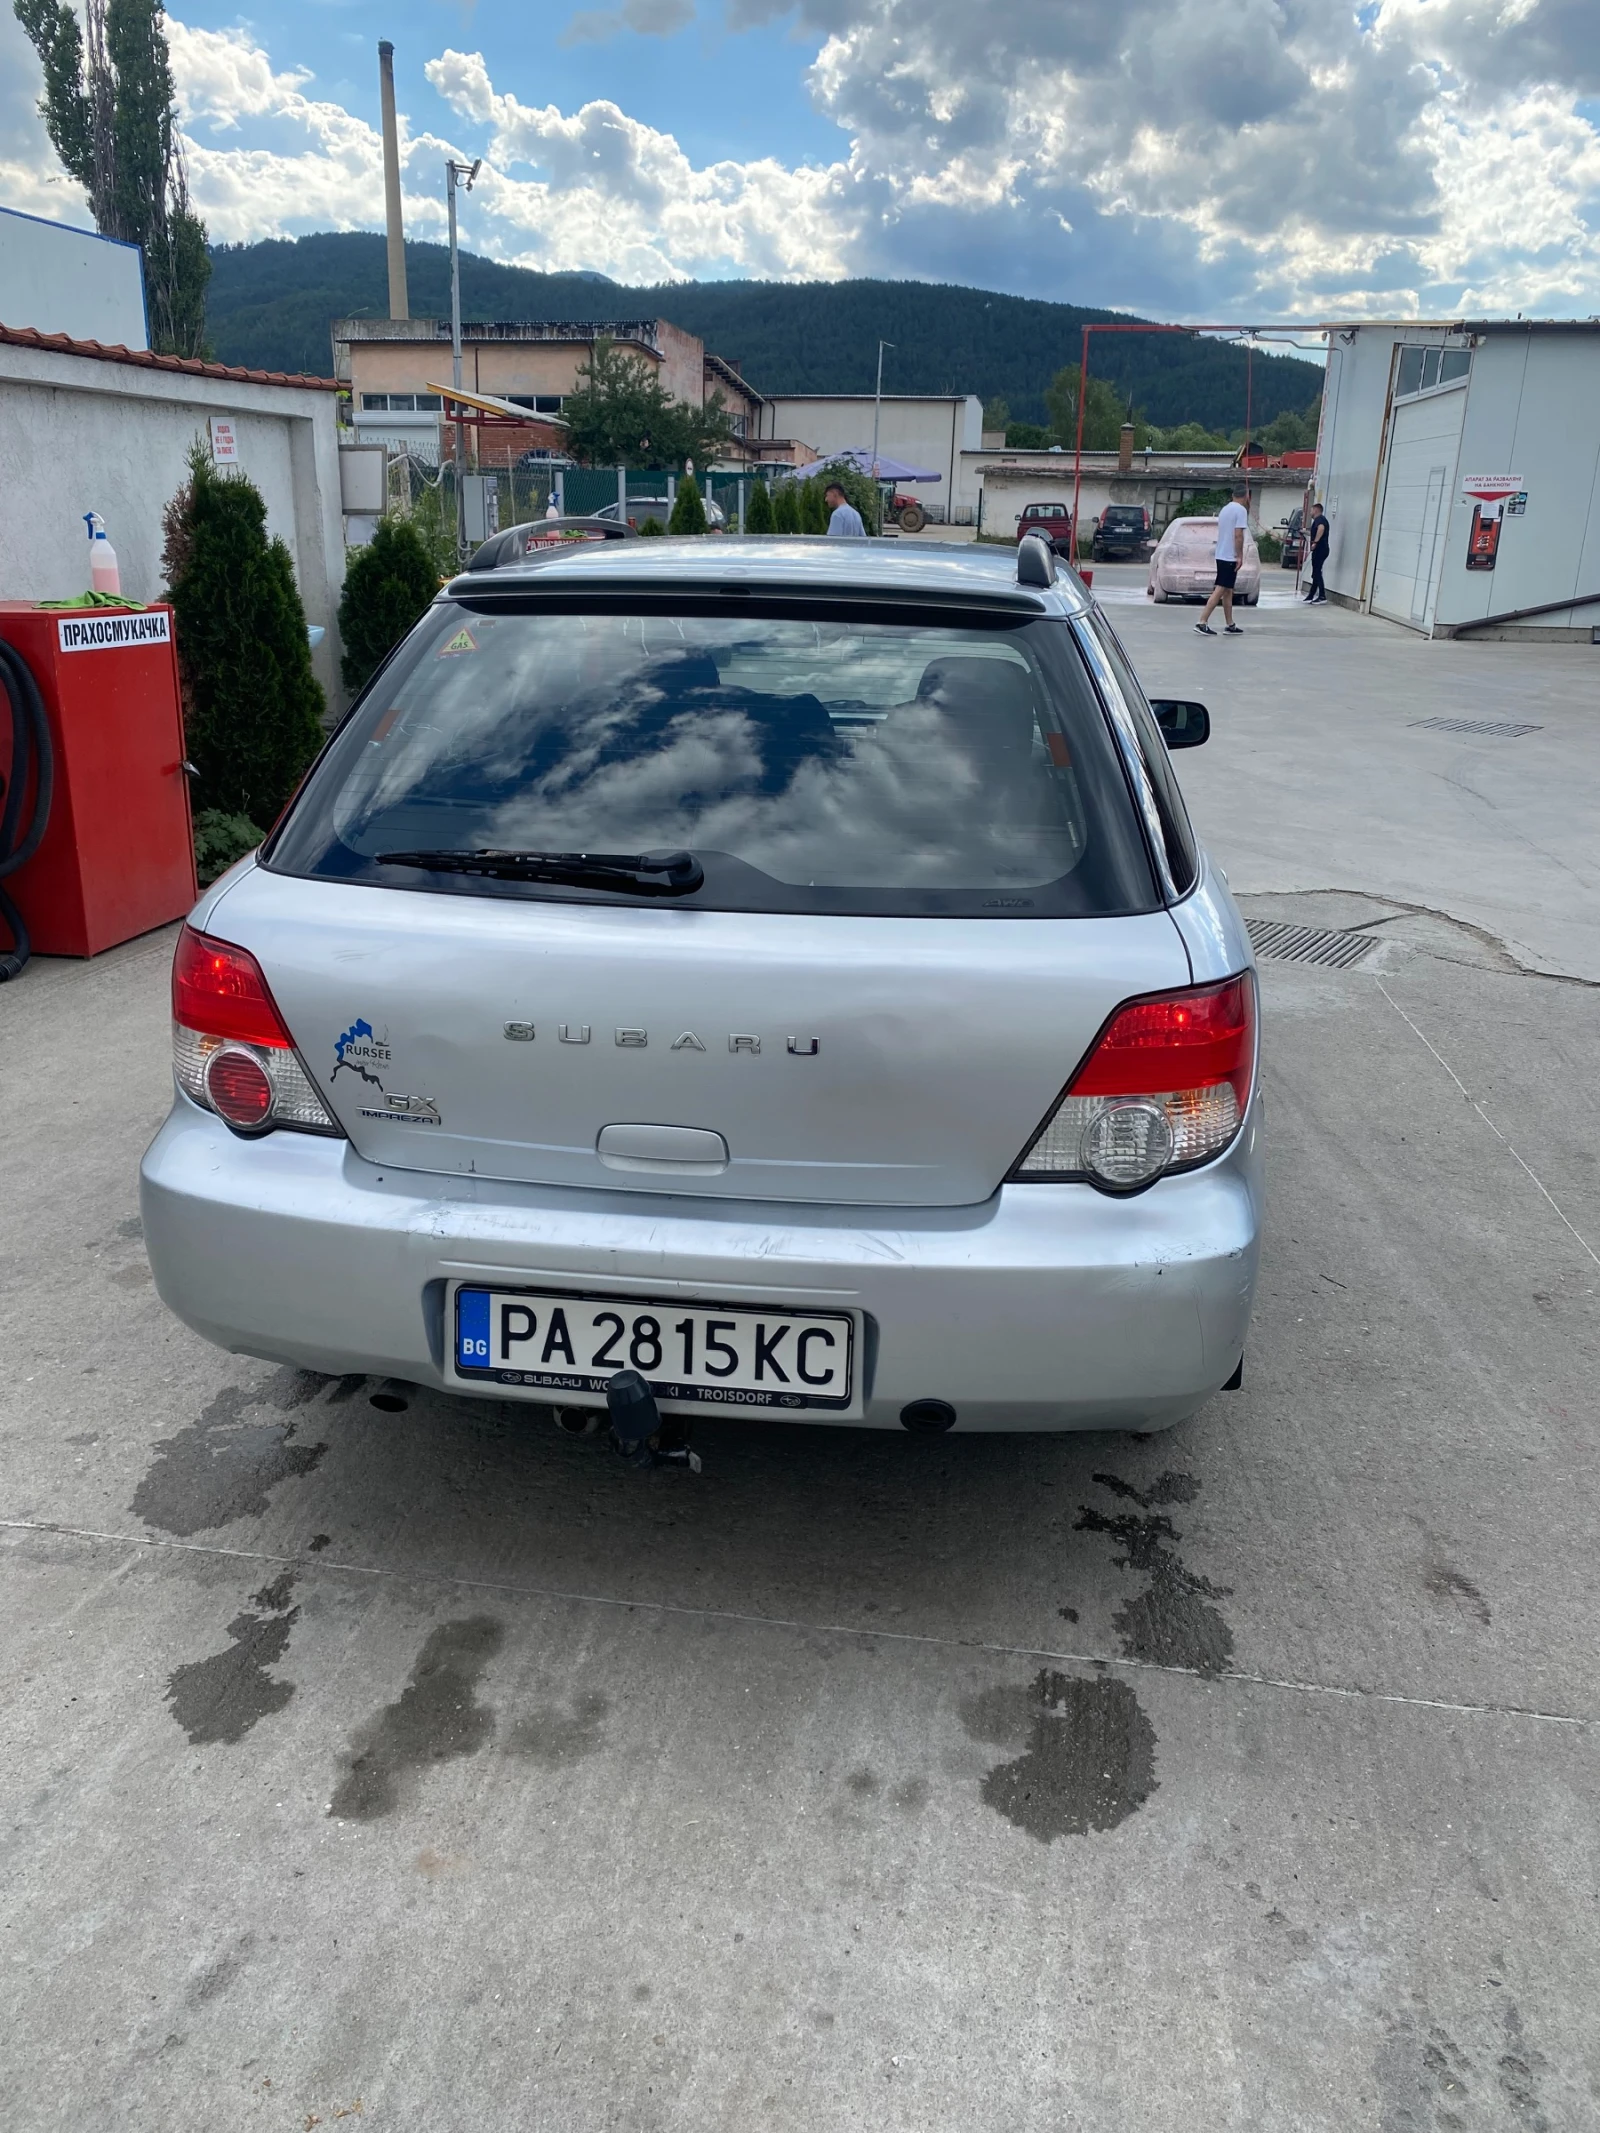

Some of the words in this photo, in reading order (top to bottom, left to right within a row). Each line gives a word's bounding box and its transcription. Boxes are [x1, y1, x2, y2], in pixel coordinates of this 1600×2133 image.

[63, 616, 167, 647] ПРАХОСМУКАЧКА
[451, 641, 469, 650] GAS
[503, 1020, 821, 1055] SUBARU
[346, 1044, 392, 1060] RURSEE
[384, 1092, 438, 1113] GX
[362, 1110, 434, 1124] IMPREZA
[463, 1338, 487, 1356] BG
[523, 1374, 582, 1388] SUBARU
[697, 1388, 773, 1405] TROISDORF
